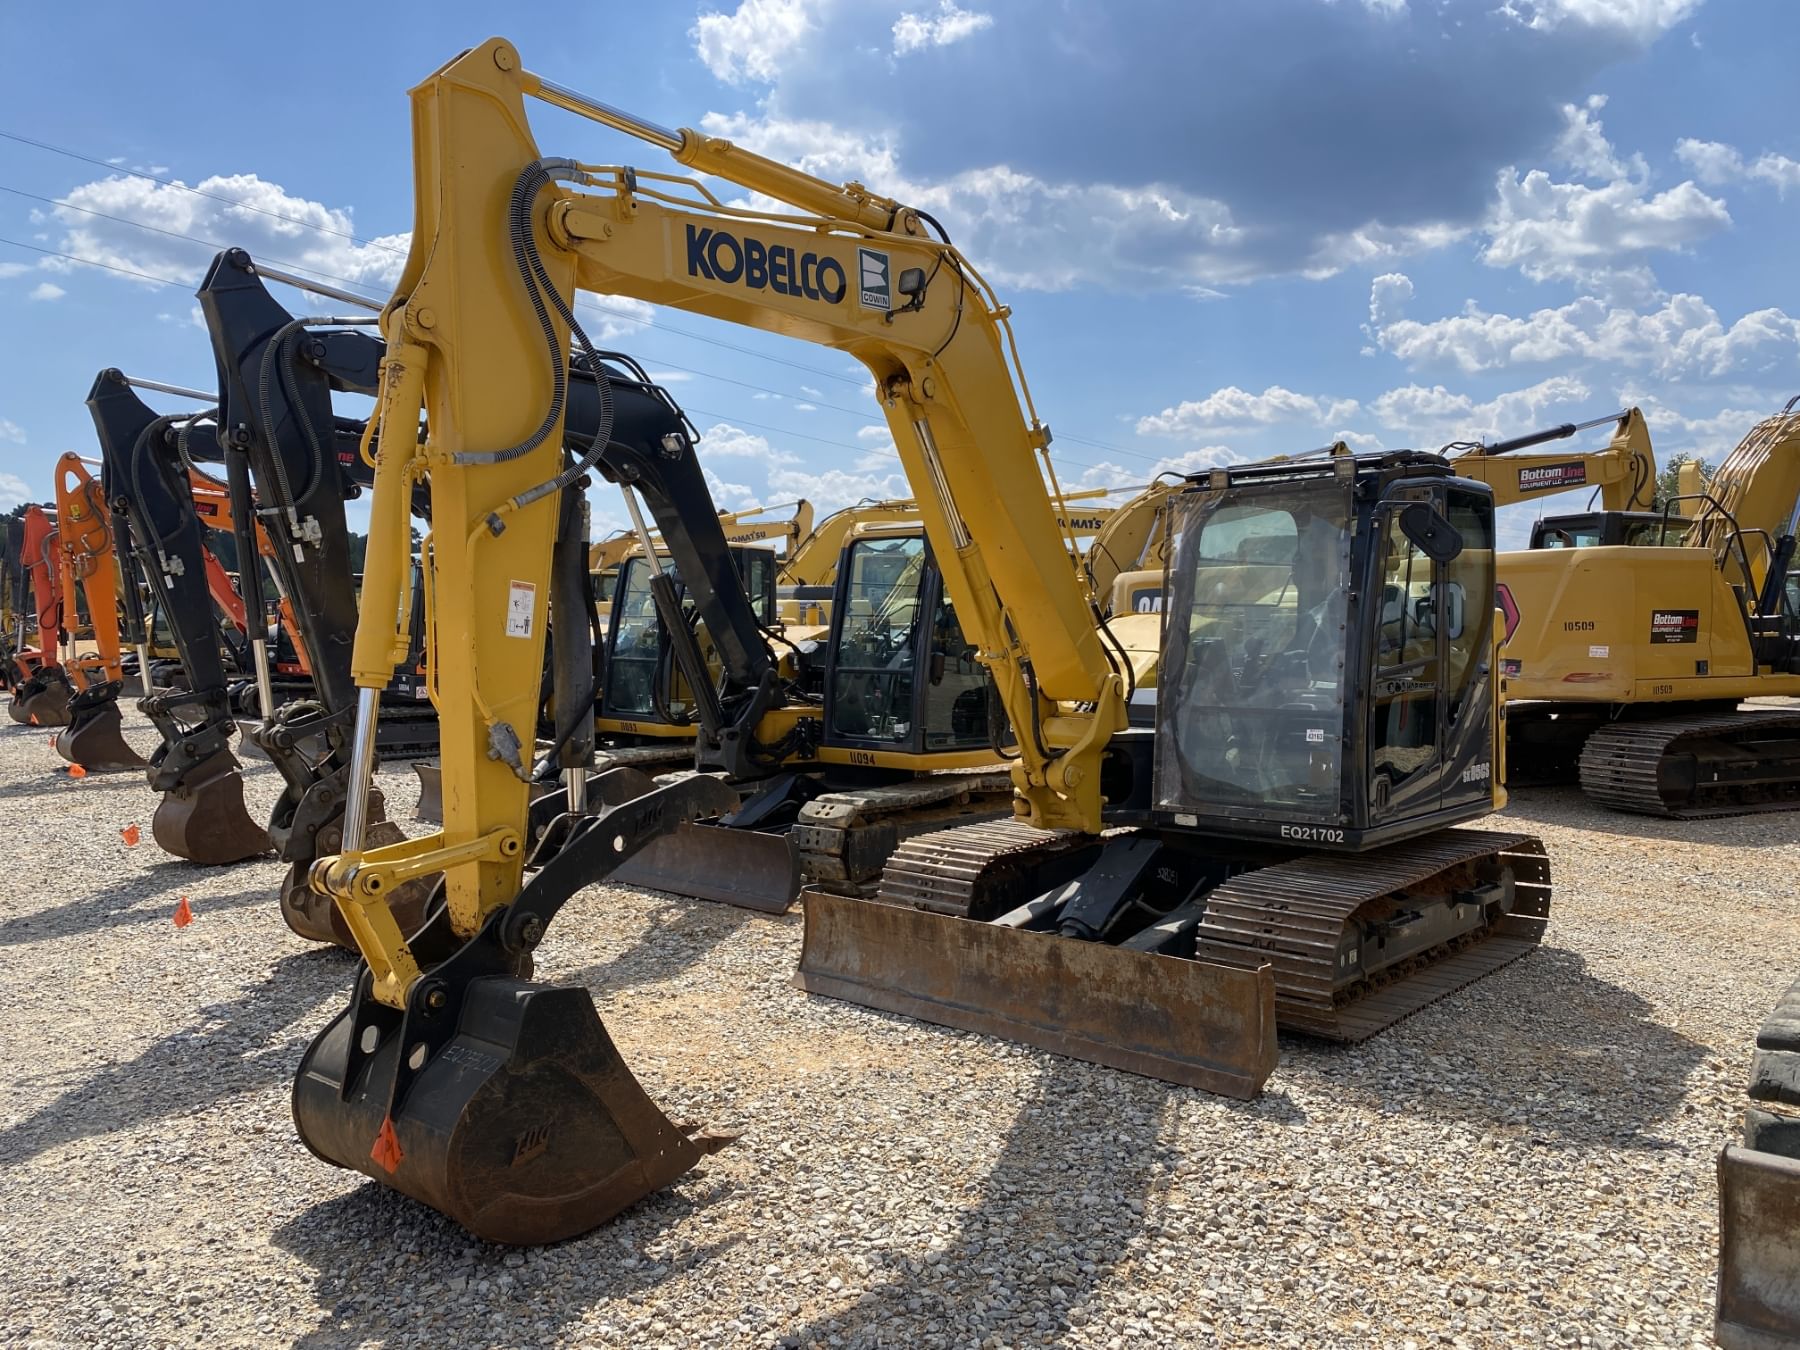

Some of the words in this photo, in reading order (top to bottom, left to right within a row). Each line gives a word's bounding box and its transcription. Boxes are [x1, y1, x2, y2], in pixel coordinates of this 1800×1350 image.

[686, 223, 847, 305] KOBELCO
[863, 292, 888, 305] COWIN
[1563, 621, 1595, 632] 10509
[1653, 685, 1673, 695] 10509
[850, 751, 875, 765] 11094
[1280, 825, 1345, 843] EQ21702
